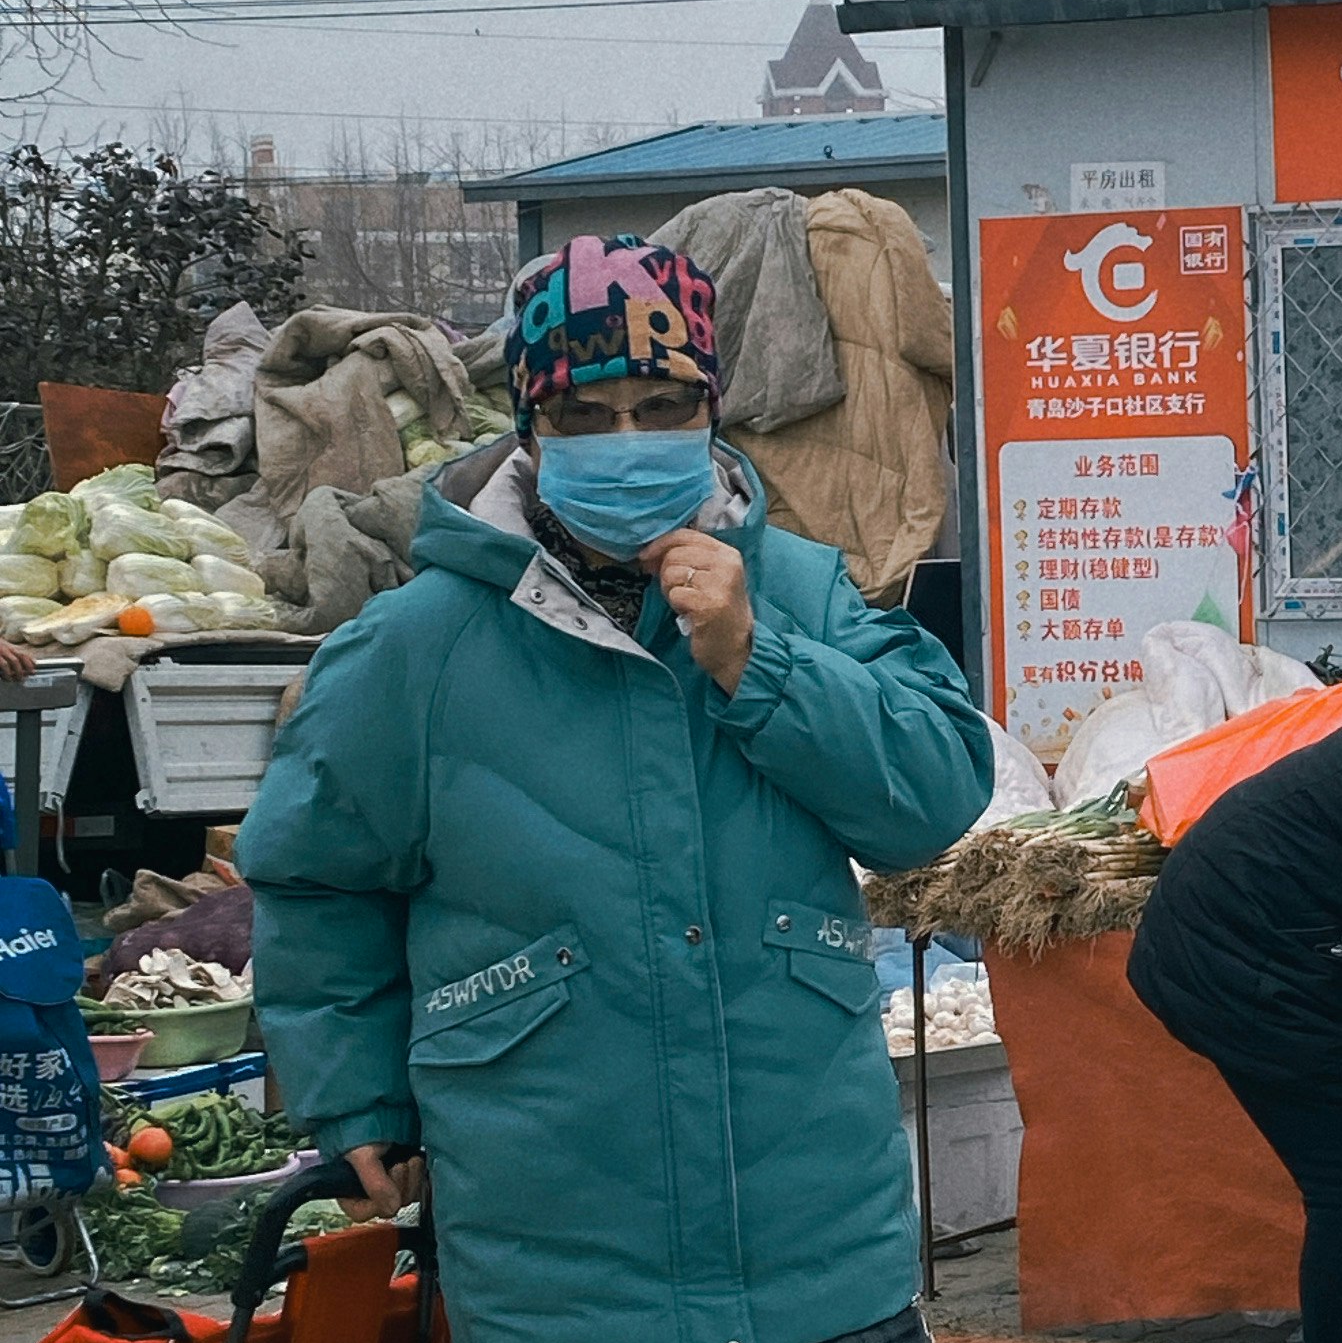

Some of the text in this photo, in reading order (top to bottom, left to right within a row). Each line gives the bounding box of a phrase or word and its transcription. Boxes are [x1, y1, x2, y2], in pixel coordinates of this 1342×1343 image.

[1080, 169, 1155, 189] 平房出租
[1026, 330, 1201, 373] 华夏银行
[1031, 370, 1198, 389] HUAXIA BANK
[1026, 392, 1206, 420] 青岛沙子口社区支行
[1074, 454, 1159, 477] 业务范围
[1037, 496, 1122, 519] 定期存款
[1039, 557, 1159, 581] 理财(稳健型)
[1040, 588, 1081, 611] 国债
[1041, 618, 1125, 641] 大额存单
